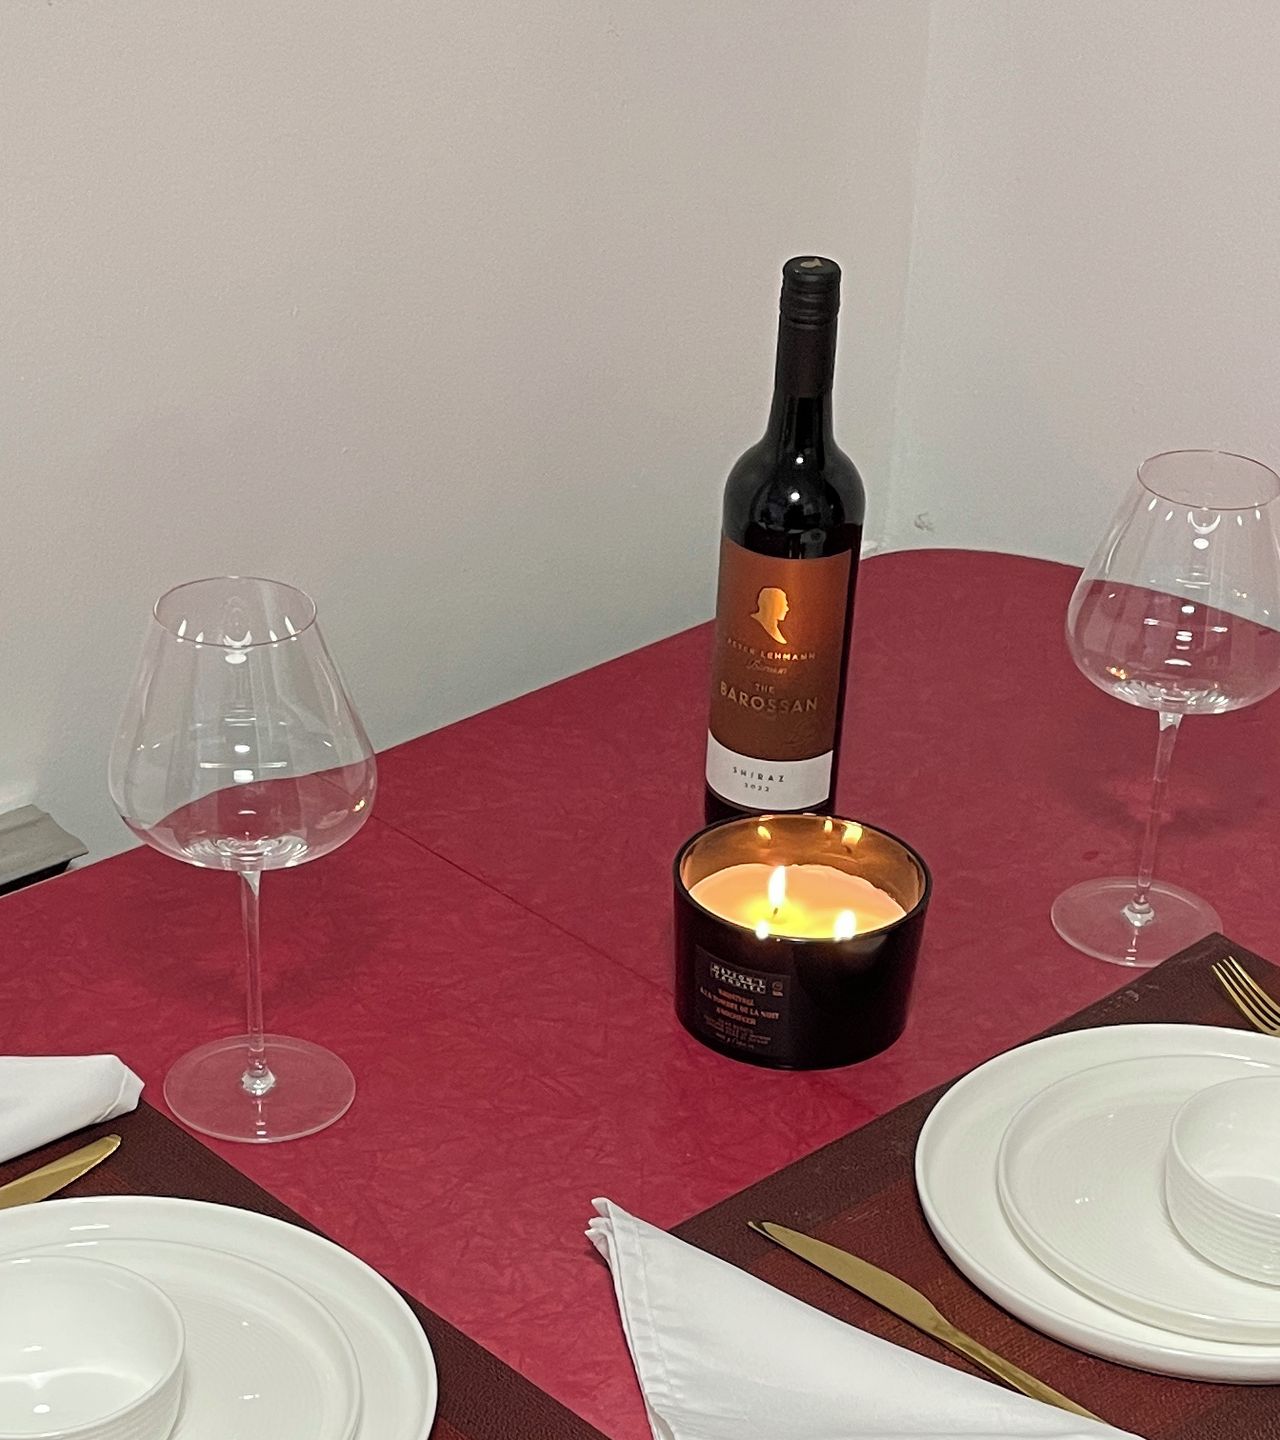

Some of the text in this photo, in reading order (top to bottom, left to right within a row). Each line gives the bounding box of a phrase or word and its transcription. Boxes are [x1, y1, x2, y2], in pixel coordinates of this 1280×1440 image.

[727, 638, 816, 661] PETER LEHMANN
[720, 680, 818, 713] BAROSSAN
[732, 766, 785, 783] SHIRAZ
